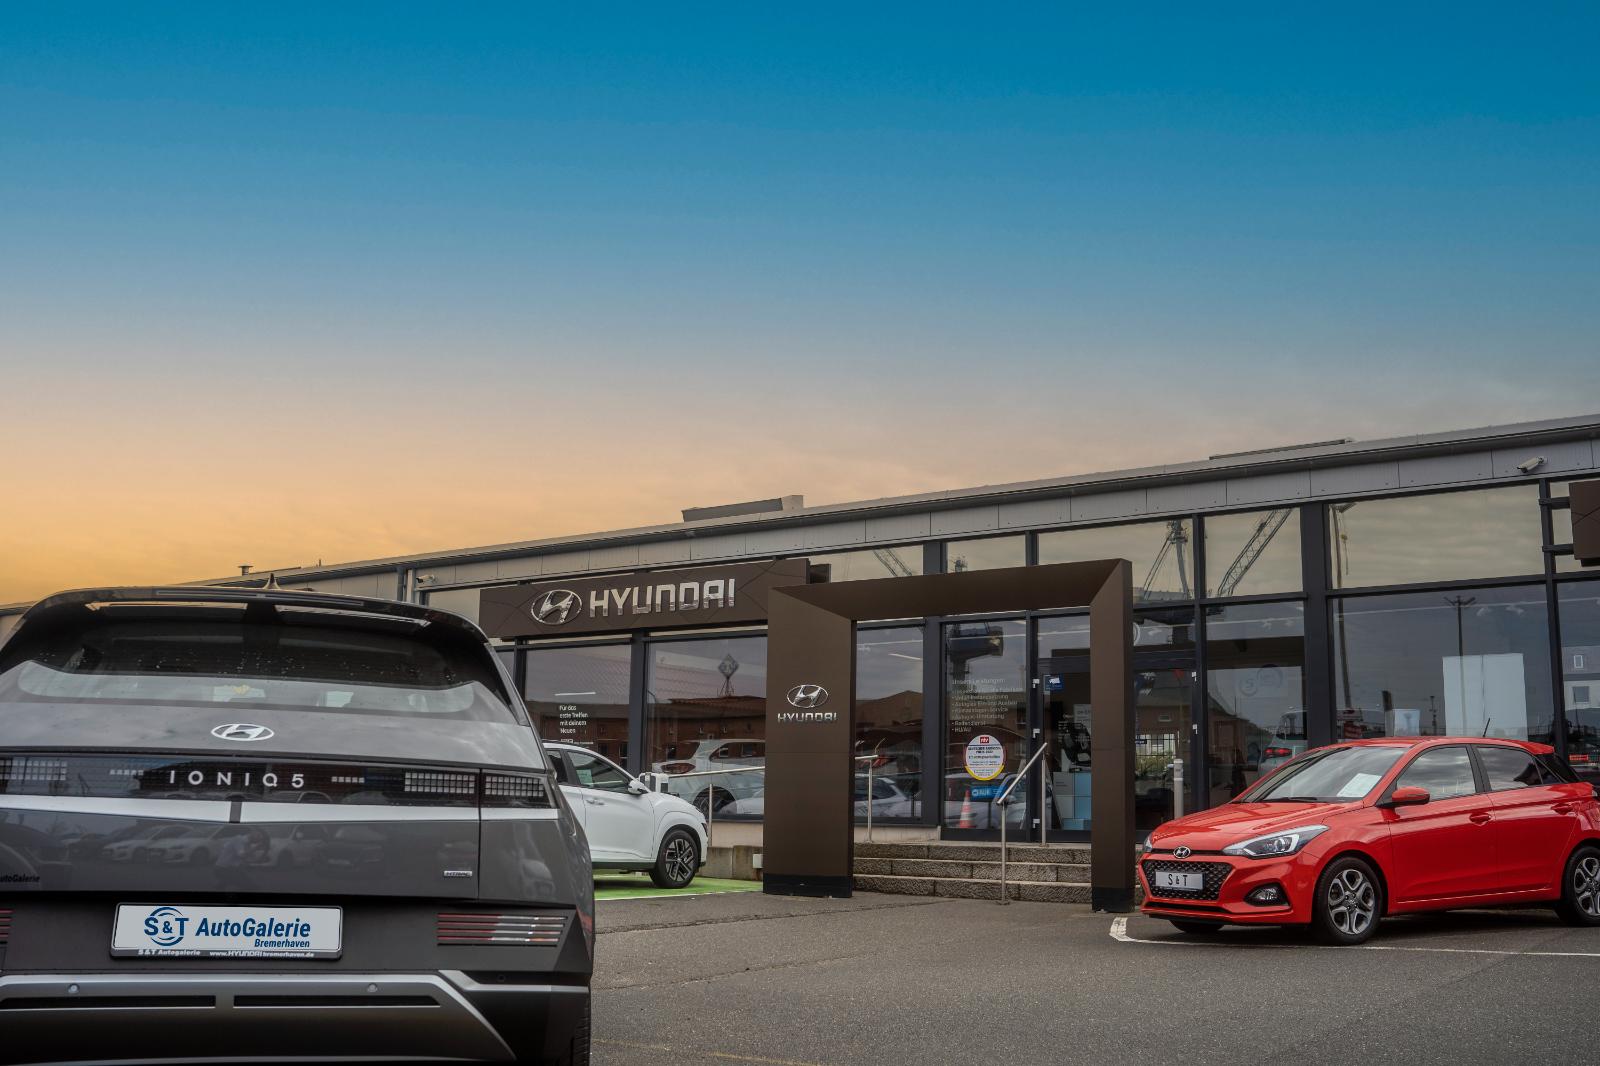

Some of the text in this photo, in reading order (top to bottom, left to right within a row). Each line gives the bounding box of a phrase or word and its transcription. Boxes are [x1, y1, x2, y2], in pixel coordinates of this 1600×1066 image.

[589, 578, 736, 618] HYUNDAI
[777, 712, 837, 722] HYUNDAI
[169, 770, 304, 788] IONIQ 5
[0, 873, 40, 882] utoGalerie
[195, 917, 311, 937] AutoGalerie
[254, 938, 310, 948] Bremerhaven
